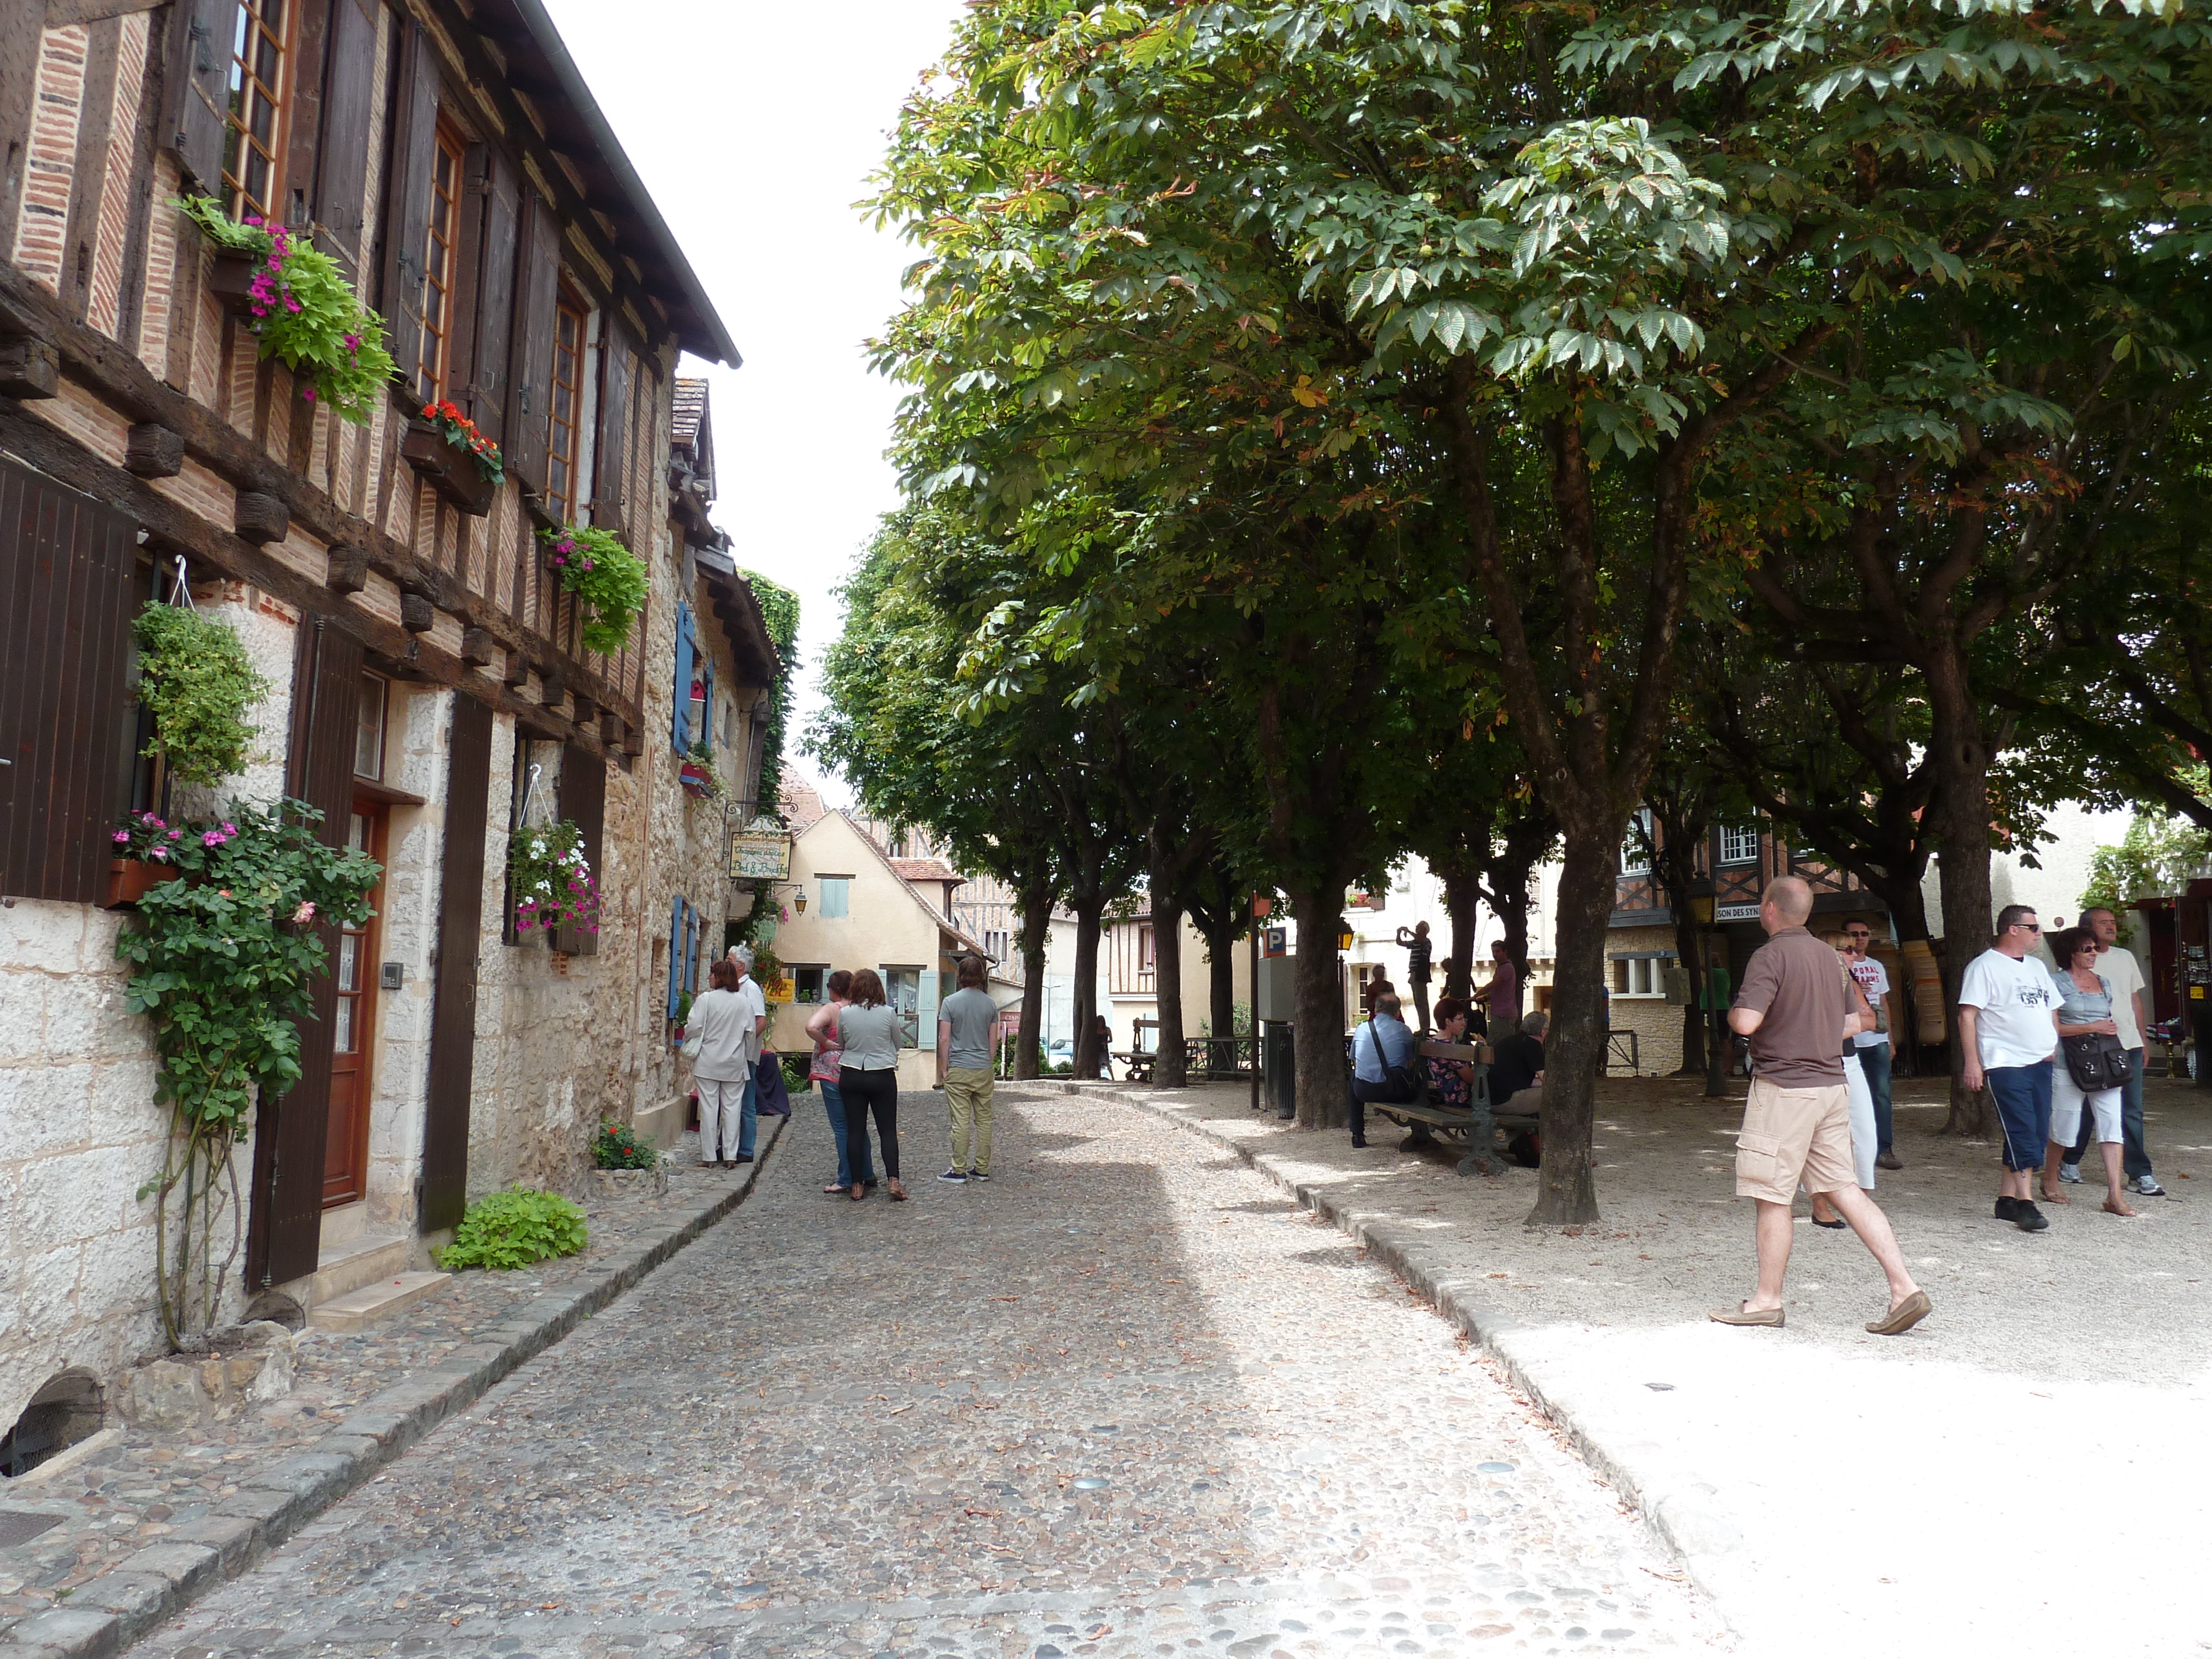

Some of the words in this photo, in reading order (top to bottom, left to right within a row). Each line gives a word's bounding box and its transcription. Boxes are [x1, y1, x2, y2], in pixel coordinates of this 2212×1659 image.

[731, 860, 748, 872] Bed
[750, 862, 758, 875] &
[1717, 909, 1731, 917] SON
[1745, 907, 1760, 916] SYN
[1269, 932, 1282, 949] P
